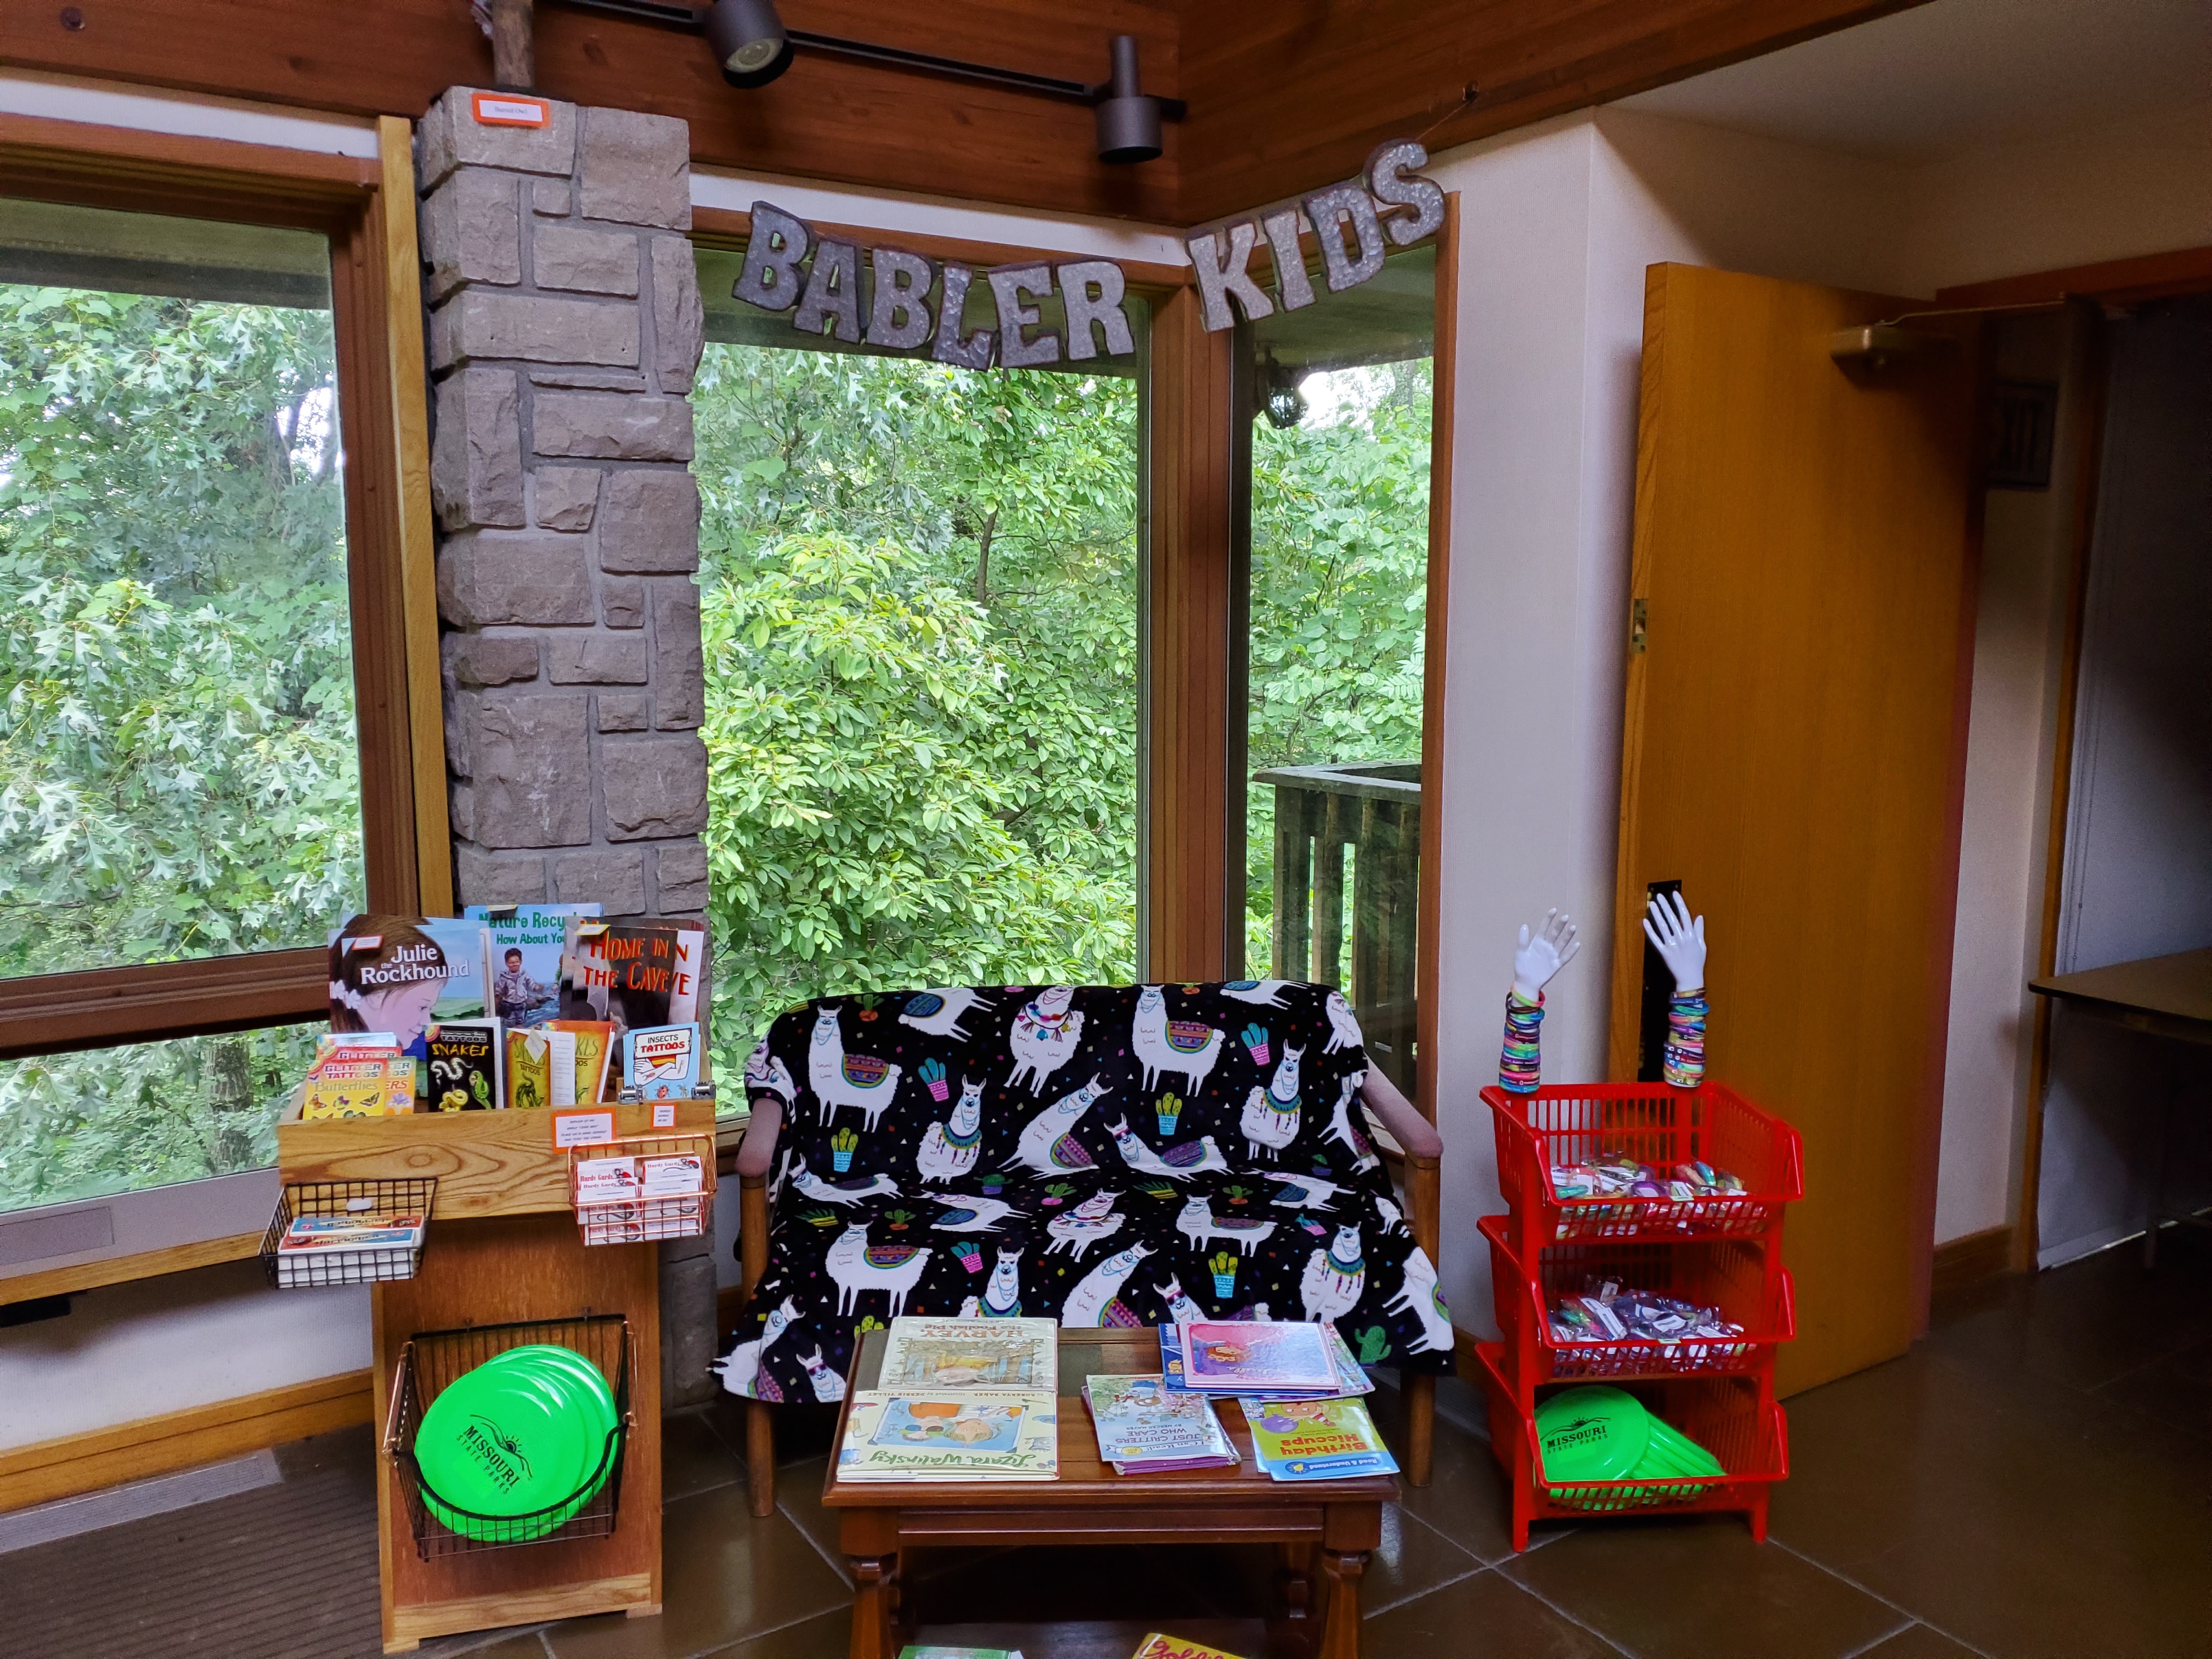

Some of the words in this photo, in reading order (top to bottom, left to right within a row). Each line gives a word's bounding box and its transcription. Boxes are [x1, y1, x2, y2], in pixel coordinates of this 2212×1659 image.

[731, 200, 1134, 370] BABLER
[1185, 138, 1445, 333] KIDS
[496, 934, 517, 944] How
[520, 933, 548, 944] About
[551, 933, 565, 944] Yo
[391, 943, 438, 963] Julie
[360, 960, 470, 985] Rockhound
[647, 1034, 679, 1043] INSECTS
[432, 1043, 489, 1057] SNAKES
[641, 1041, 685, 1053] TATTOOS
[325, 1064, 381, 1072] GLITTER
[520, 1064, 540, 1076] TATTOOS
[315, 1080, 378, 1092] Butterflies
[1115, 1436, 1168, 1444] CRITTERS
[1172, 1433, 1200, 1441] JUST
[1280, 1433, 1359, 1446] Hiccups
[1547, 1425, 1607, 1449] MISSOURI
[1147, 1443, 1175, 1452] Read!
[1279, 1442, 1368, 1456] Birthday
[464, 1424, 521, 1488] MISSOURI
[867, 1451, 962, 1465] Walinsky
[967, 1453, 1036, 1468] Lizard
[456, 1434, 481, 1463] STATE
[483, 1465, 510, 1494] PARKS
[1309, 1460, 1351, 1470] Understand
